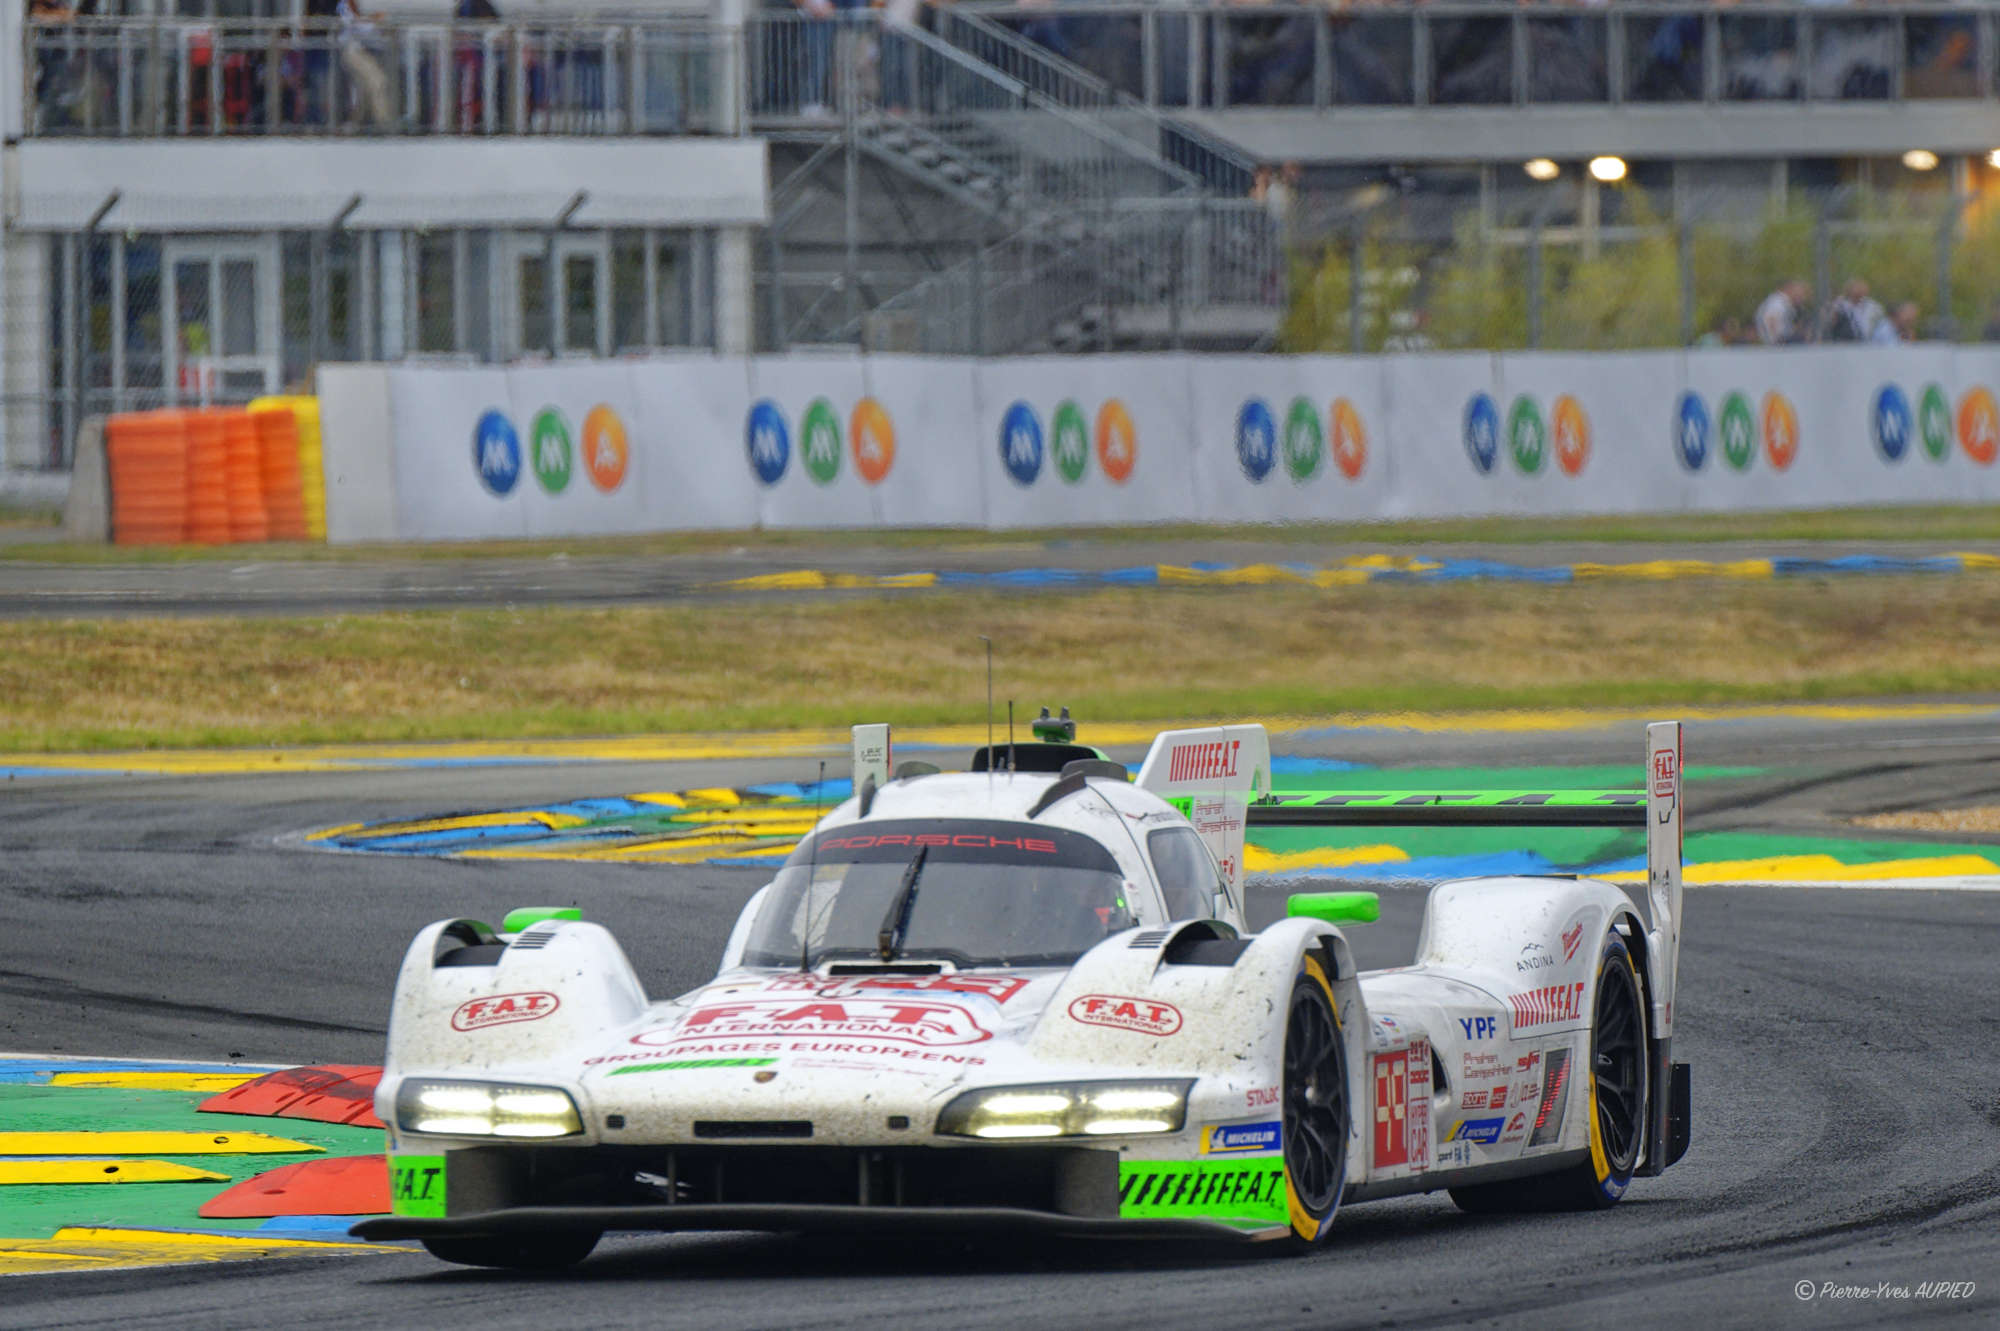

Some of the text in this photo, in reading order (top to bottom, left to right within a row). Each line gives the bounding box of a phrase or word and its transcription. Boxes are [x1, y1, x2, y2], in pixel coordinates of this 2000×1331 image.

[819, 834, 1057, 853] PORSCHE
[1459, 1016, 1496, 1041] YPF
[583, 1042, 986, 1066] GROUPAGES EUROPÉENS
[1225, 1130, 1276, 1145] MICHELIN
